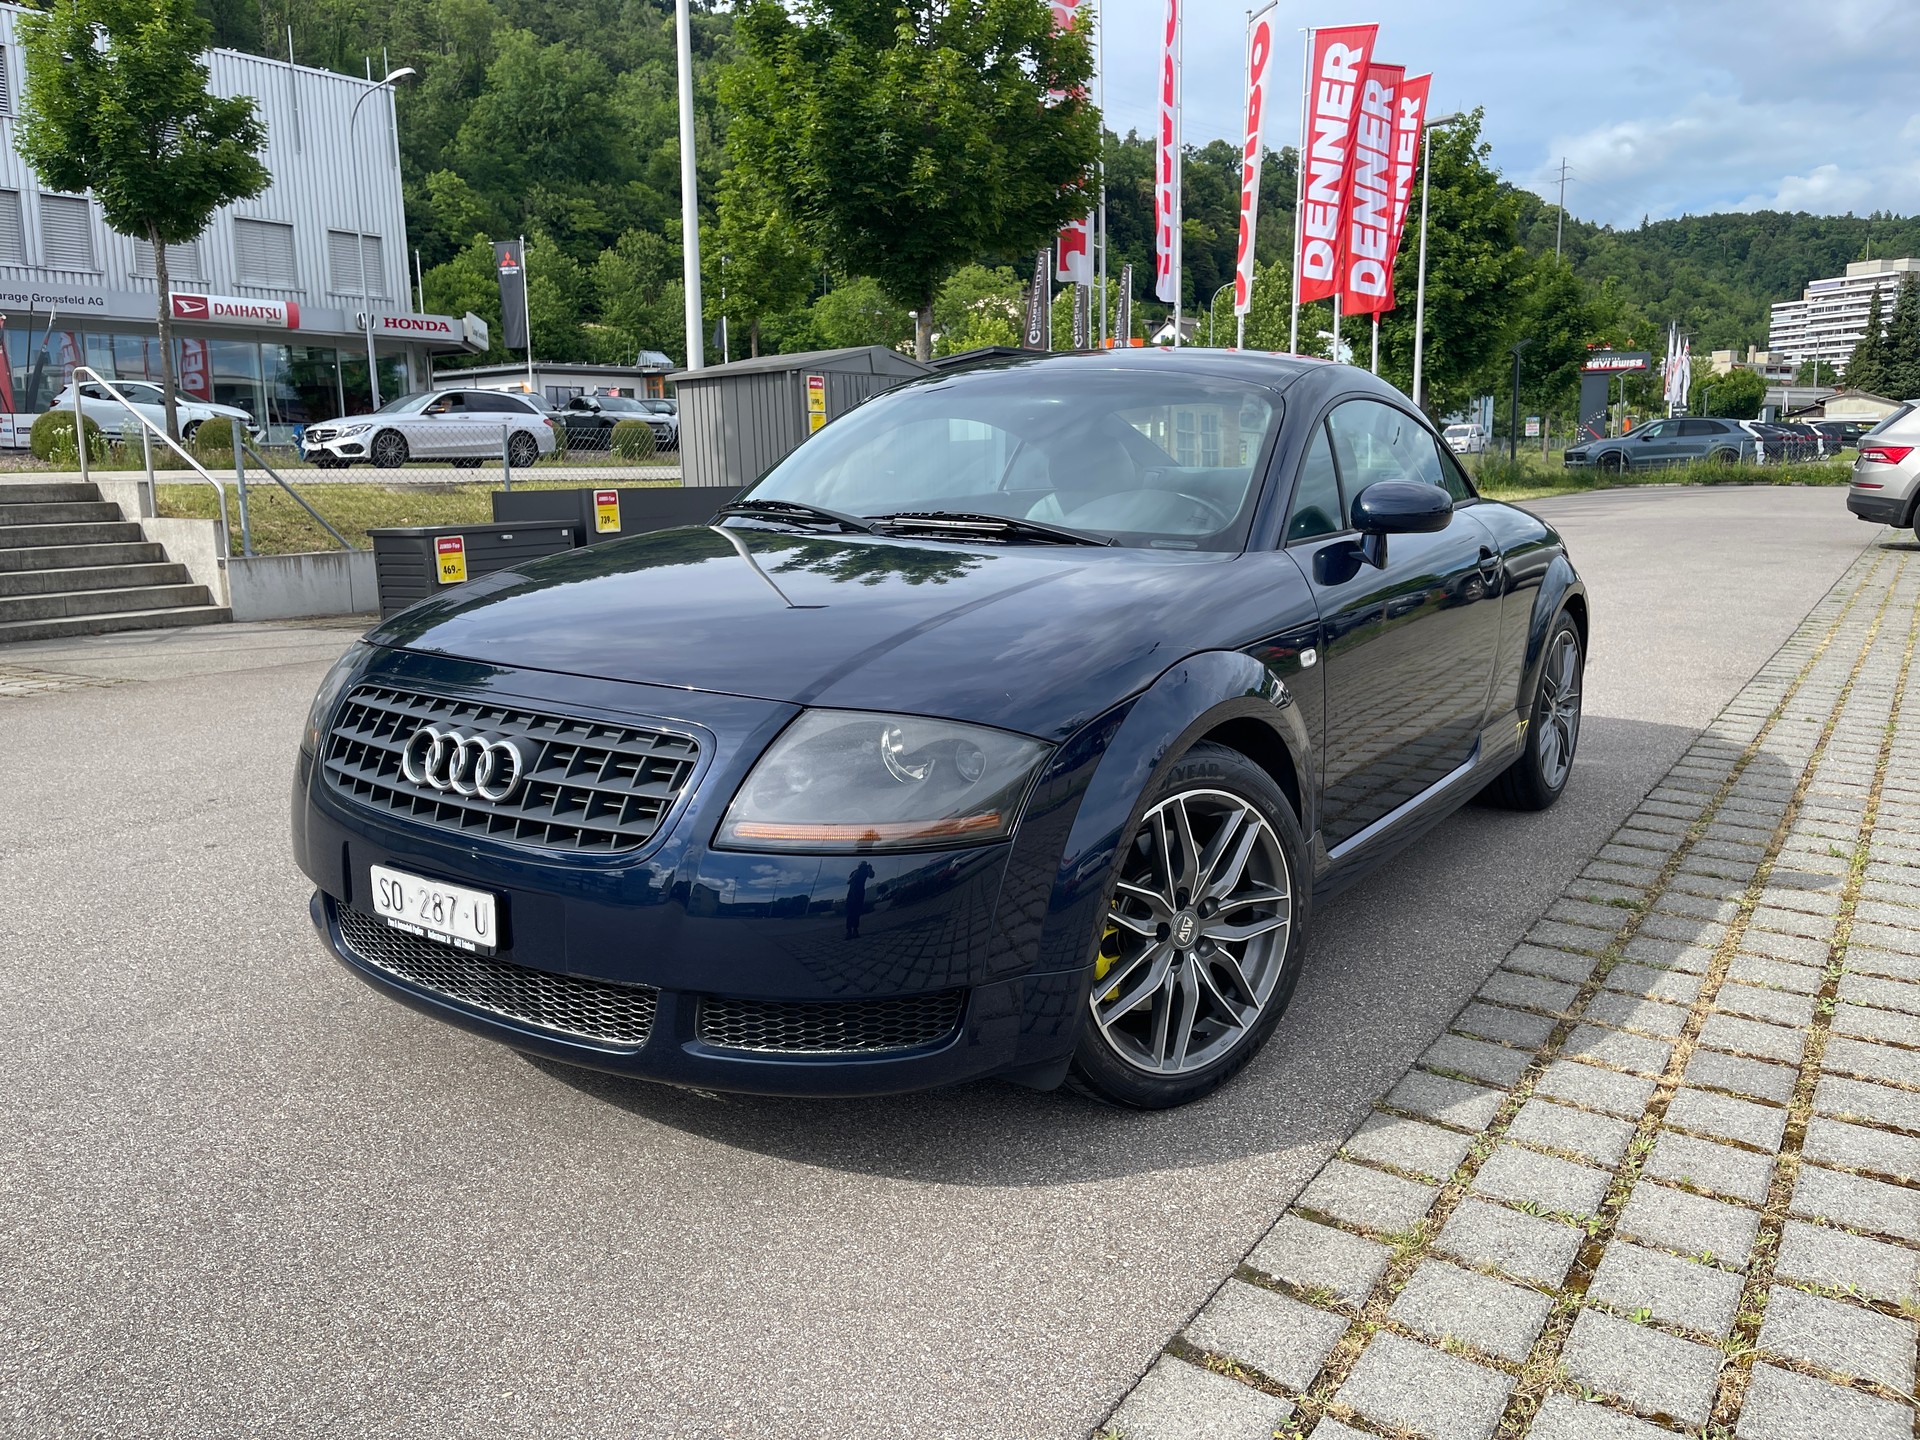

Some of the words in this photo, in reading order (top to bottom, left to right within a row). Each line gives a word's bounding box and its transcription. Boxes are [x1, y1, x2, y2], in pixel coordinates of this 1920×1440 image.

[1303, 42, 1363, 281] DENNER
[1350, 79, 1394, 297] DENNER
[0, 292, 28, 303] rage
[32, 293, 84, 305] Grossfeld
[88, 297, 104, 306] AG
[214, 303, 282, 320] DAIHATSU
[383, 317, 451, 332] HONDA
[1611, 359, 1643, 368] SWISS
[379, 877, 404, 913] SO
[418, 889, 458, 930] 287
[473, 899, 489, 937] U
